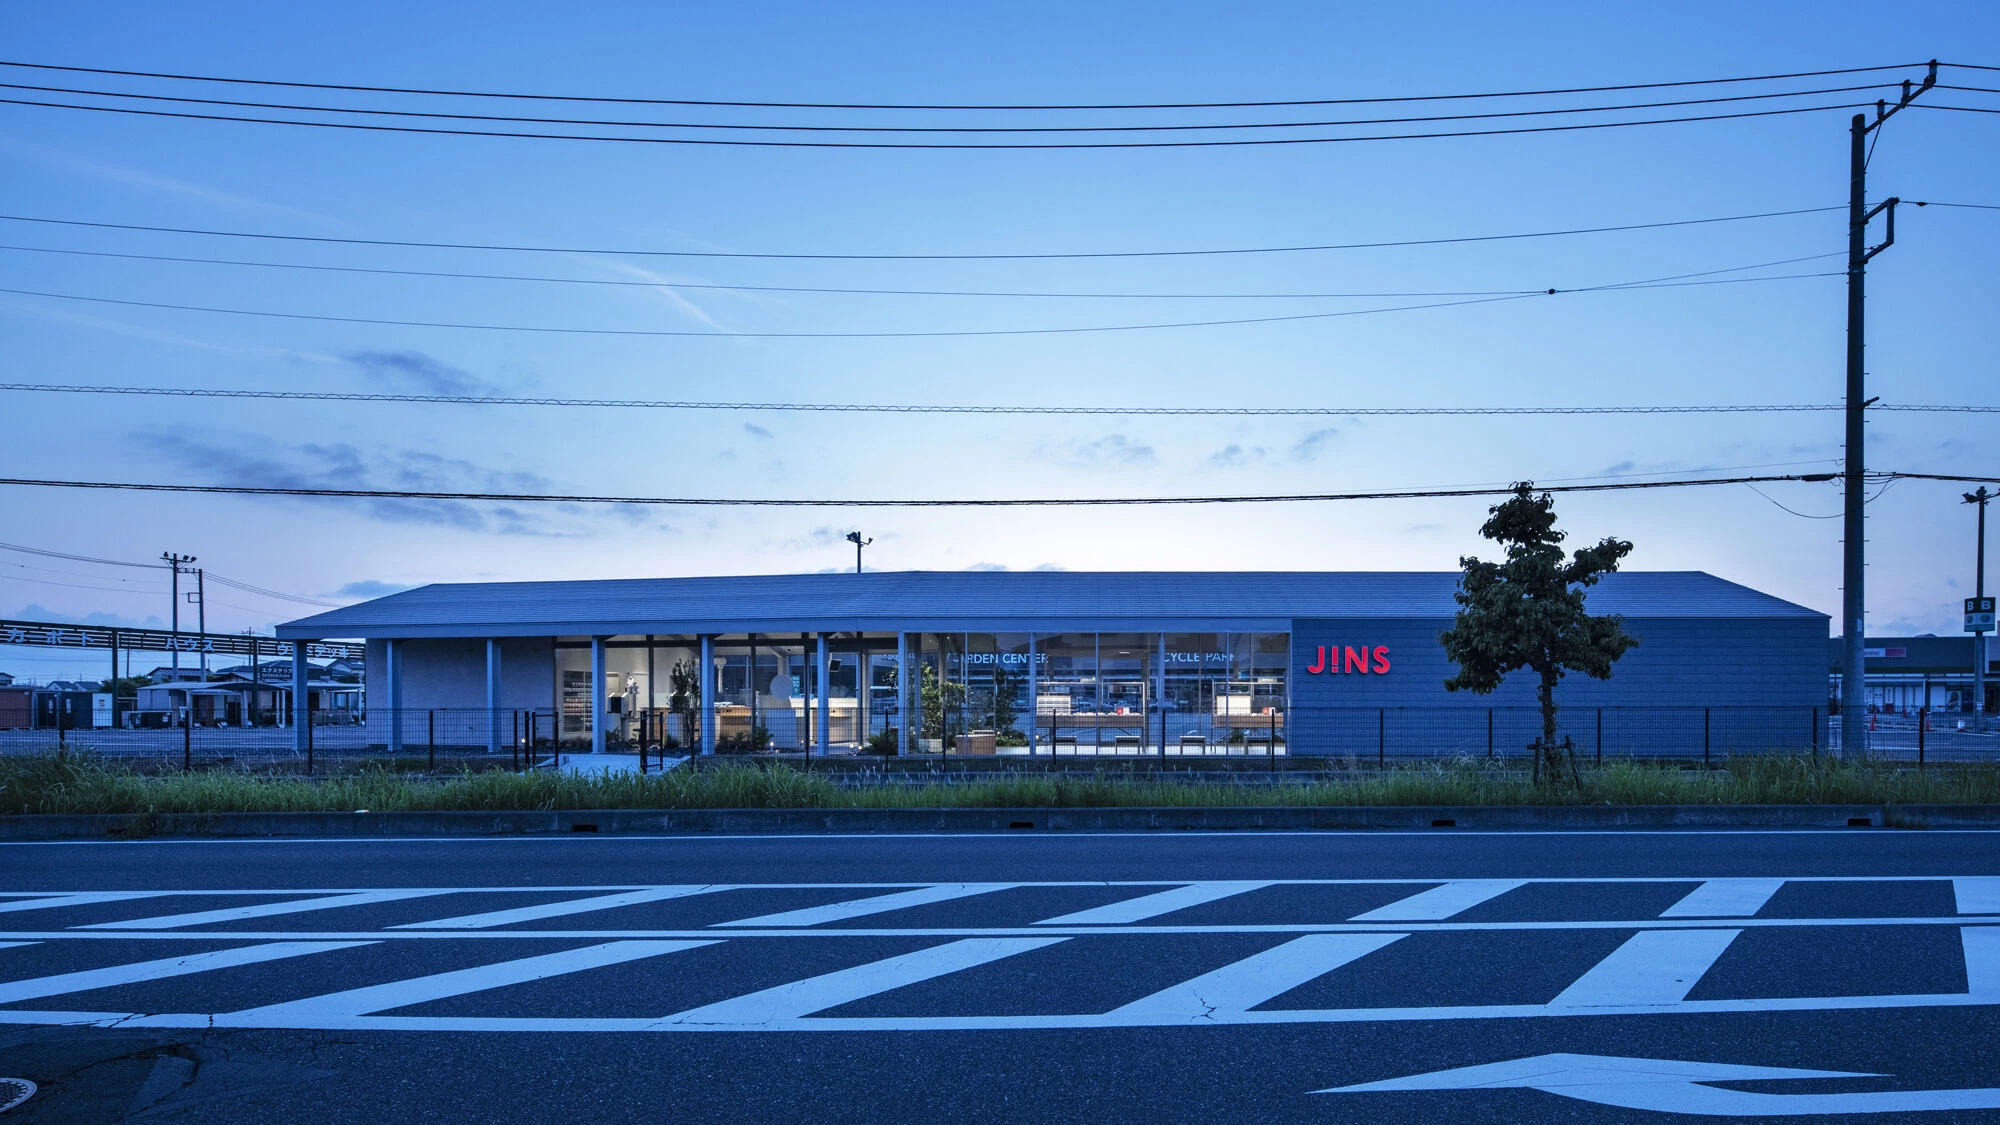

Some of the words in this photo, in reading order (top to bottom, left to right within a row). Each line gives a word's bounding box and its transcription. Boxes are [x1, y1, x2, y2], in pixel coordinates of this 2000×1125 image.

[1967, 601, 1974, 611] B
[1981, 600, 1991, 610] B
[7, 628, 94, 646] カーポート
[165, 637, 215, 652] ハウス
[1306, 645, 1391, 674] JINS
